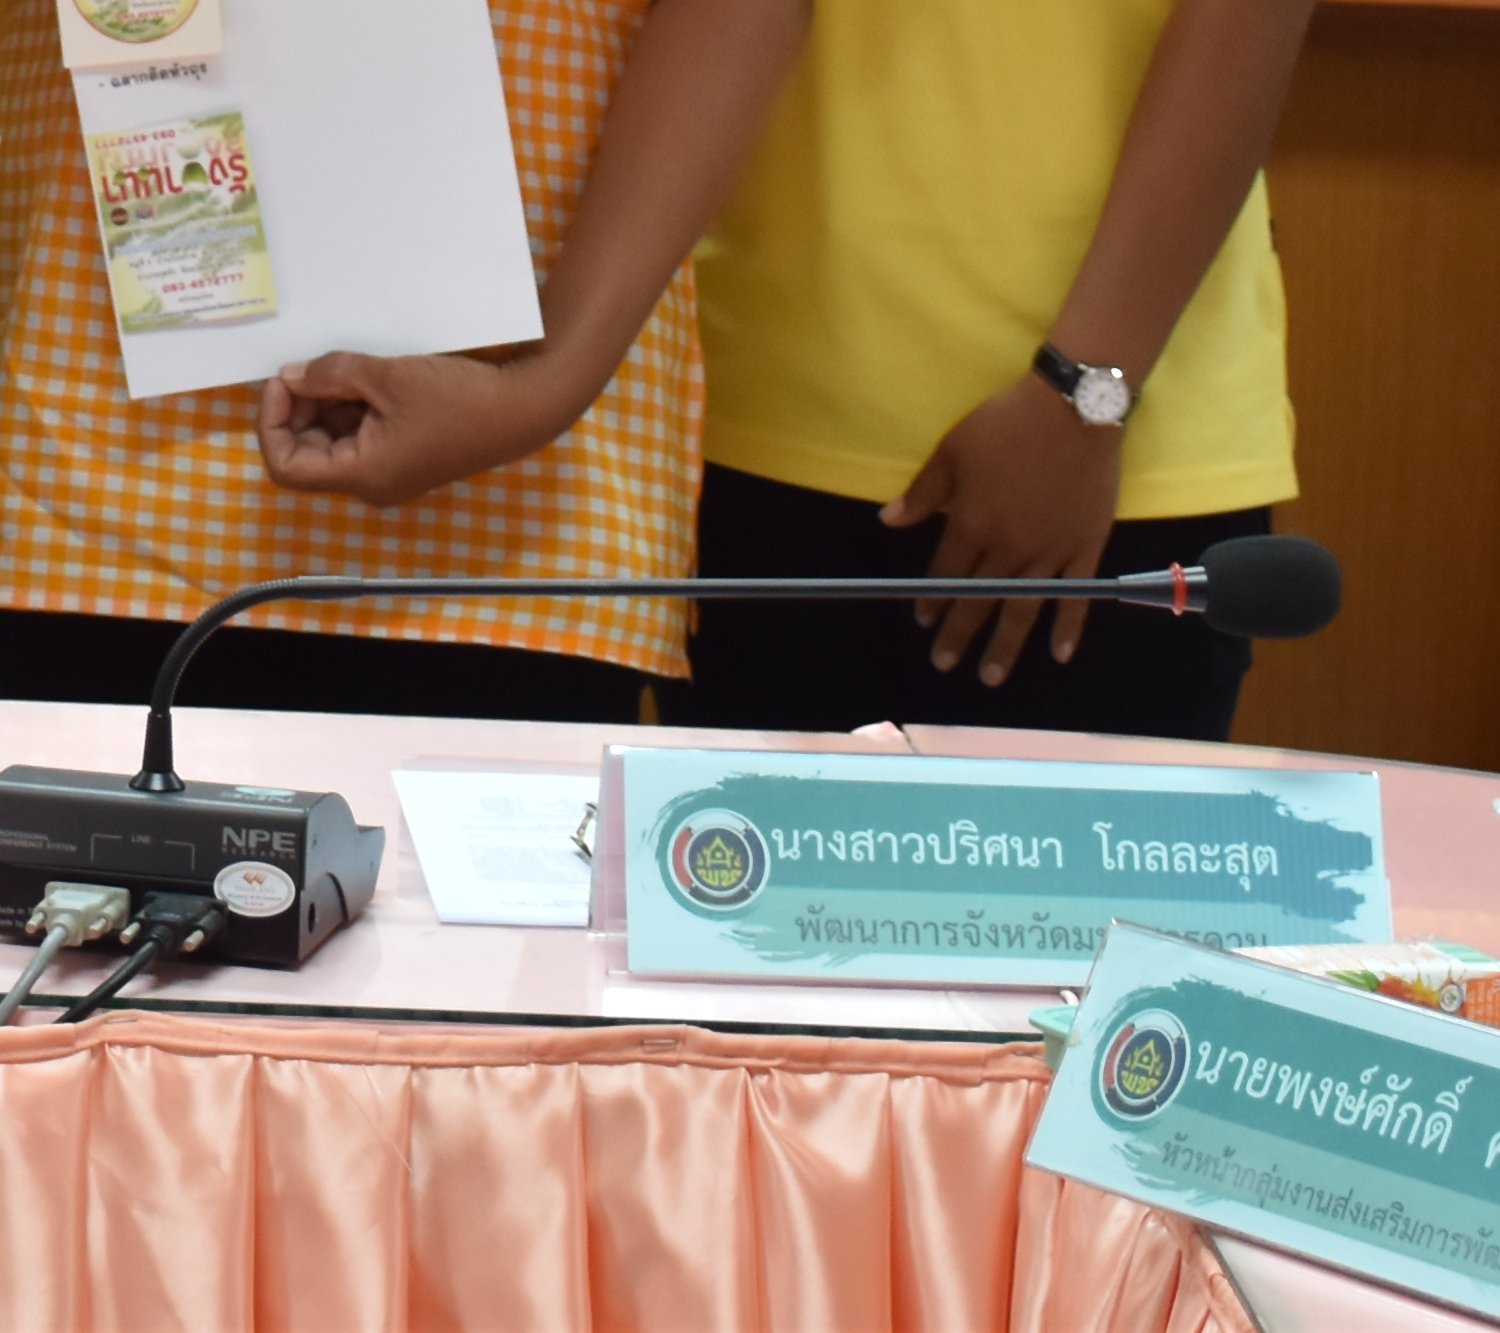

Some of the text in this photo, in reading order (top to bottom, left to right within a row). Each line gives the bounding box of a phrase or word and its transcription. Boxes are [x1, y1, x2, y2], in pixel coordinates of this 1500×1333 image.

[131, 835, 152, 845] LINE
[222, 825, 296, 853] NPE
[771, 819, 1281, 892] นางสาวปริศนา โกลละสุต
[1195, 1038, 1470, 1154] นายพงษ์ศักดิ์
